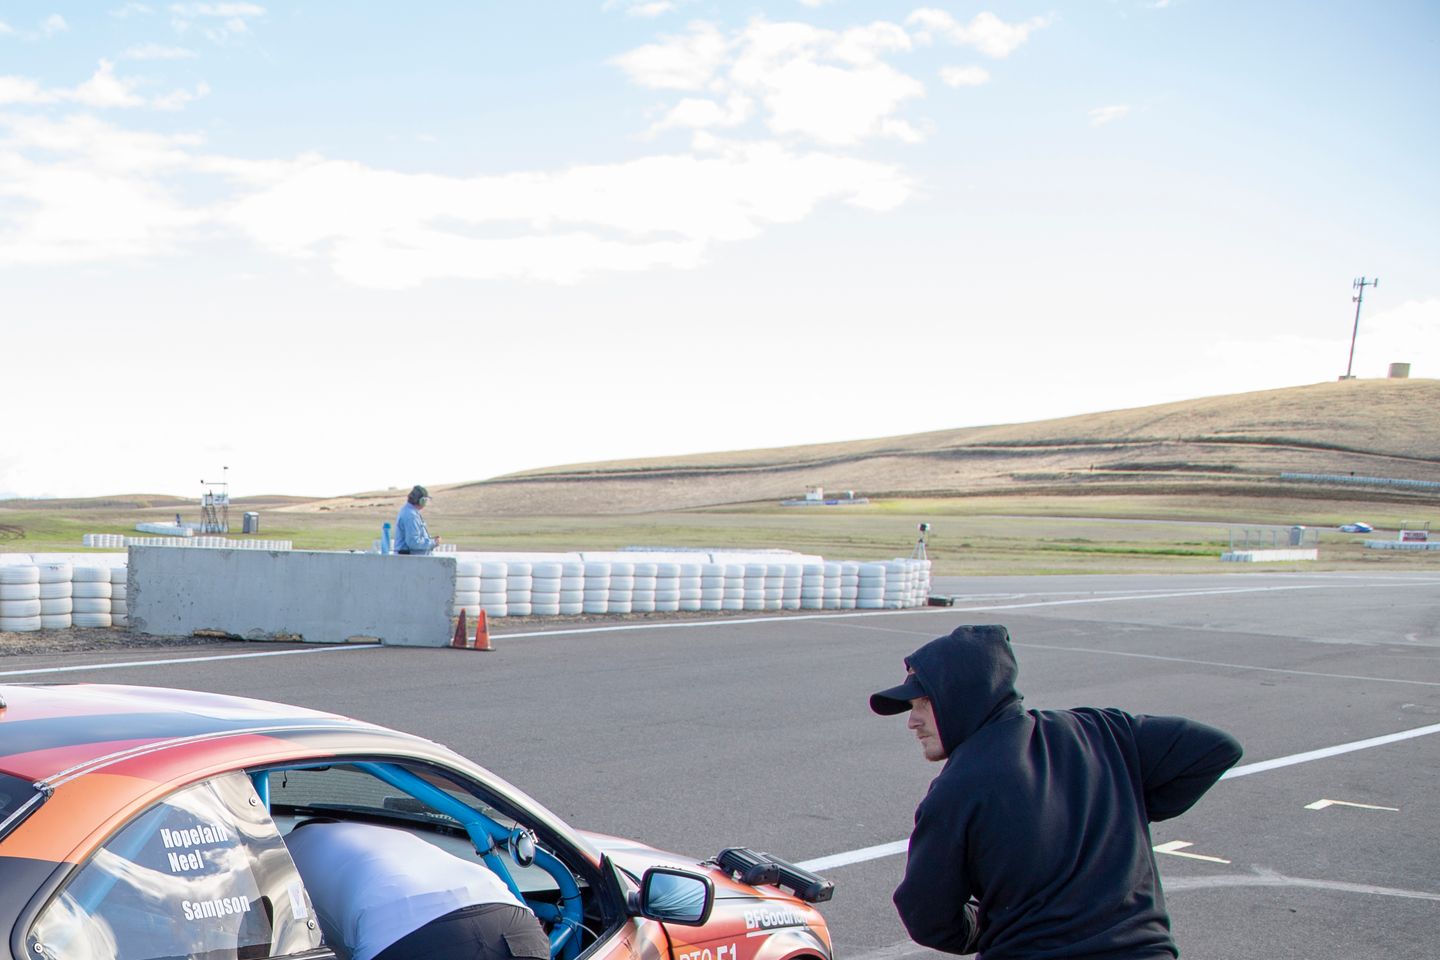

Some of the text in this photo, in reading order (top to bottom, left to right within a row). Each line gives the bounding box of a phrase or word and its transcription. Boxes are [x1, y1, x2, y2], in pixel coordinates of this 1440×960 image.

[160, 824, 229, 849] Hopelain
[167, 849, 205, 873] Neel
[181, 895, 251, 921] Sampson
